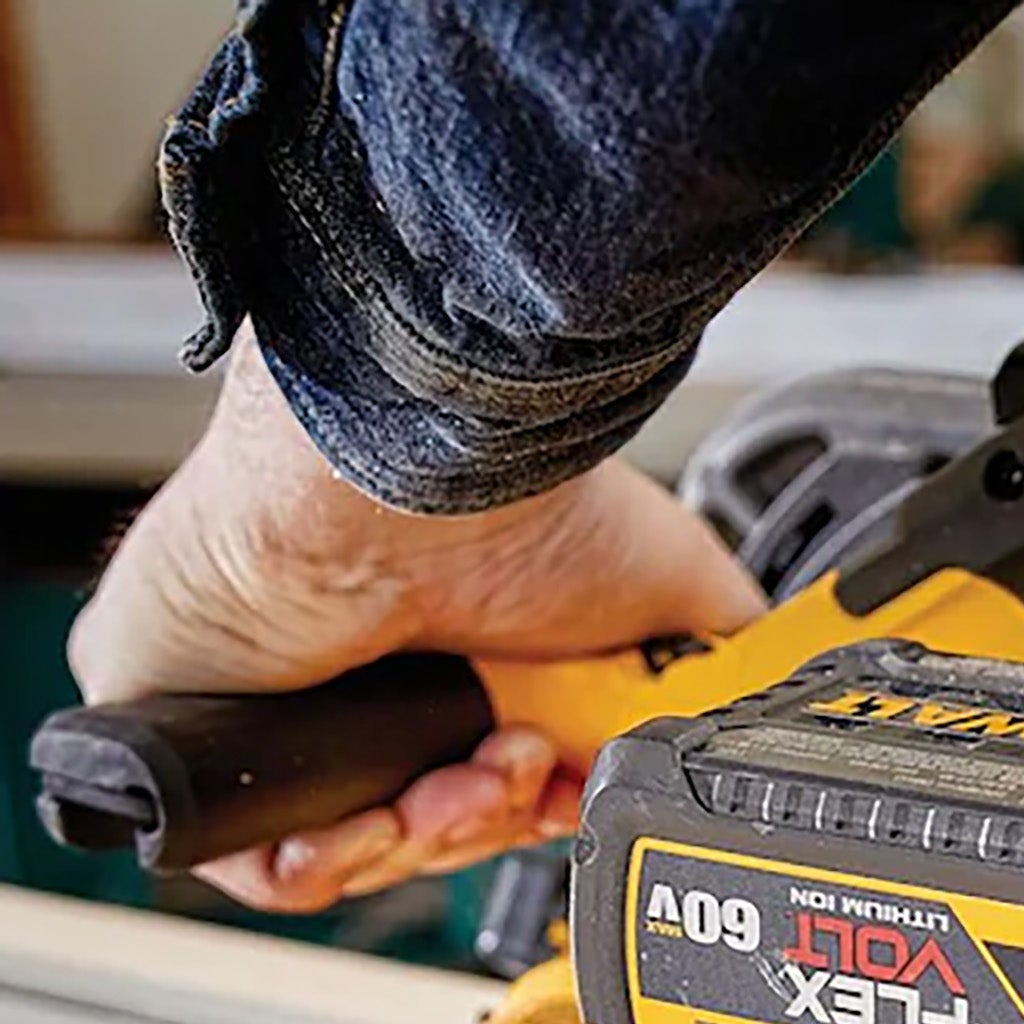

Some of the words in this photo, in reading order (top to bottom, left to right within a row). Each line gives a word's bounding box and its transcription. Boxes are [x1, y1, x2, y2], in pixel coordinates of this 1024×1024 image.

[647, 884, 760, 952] 60V
[790, 887, 835, 910] ION
[842, 899, 949, 932] LITHIUM
[784, 912, 967, 995] VOLT
